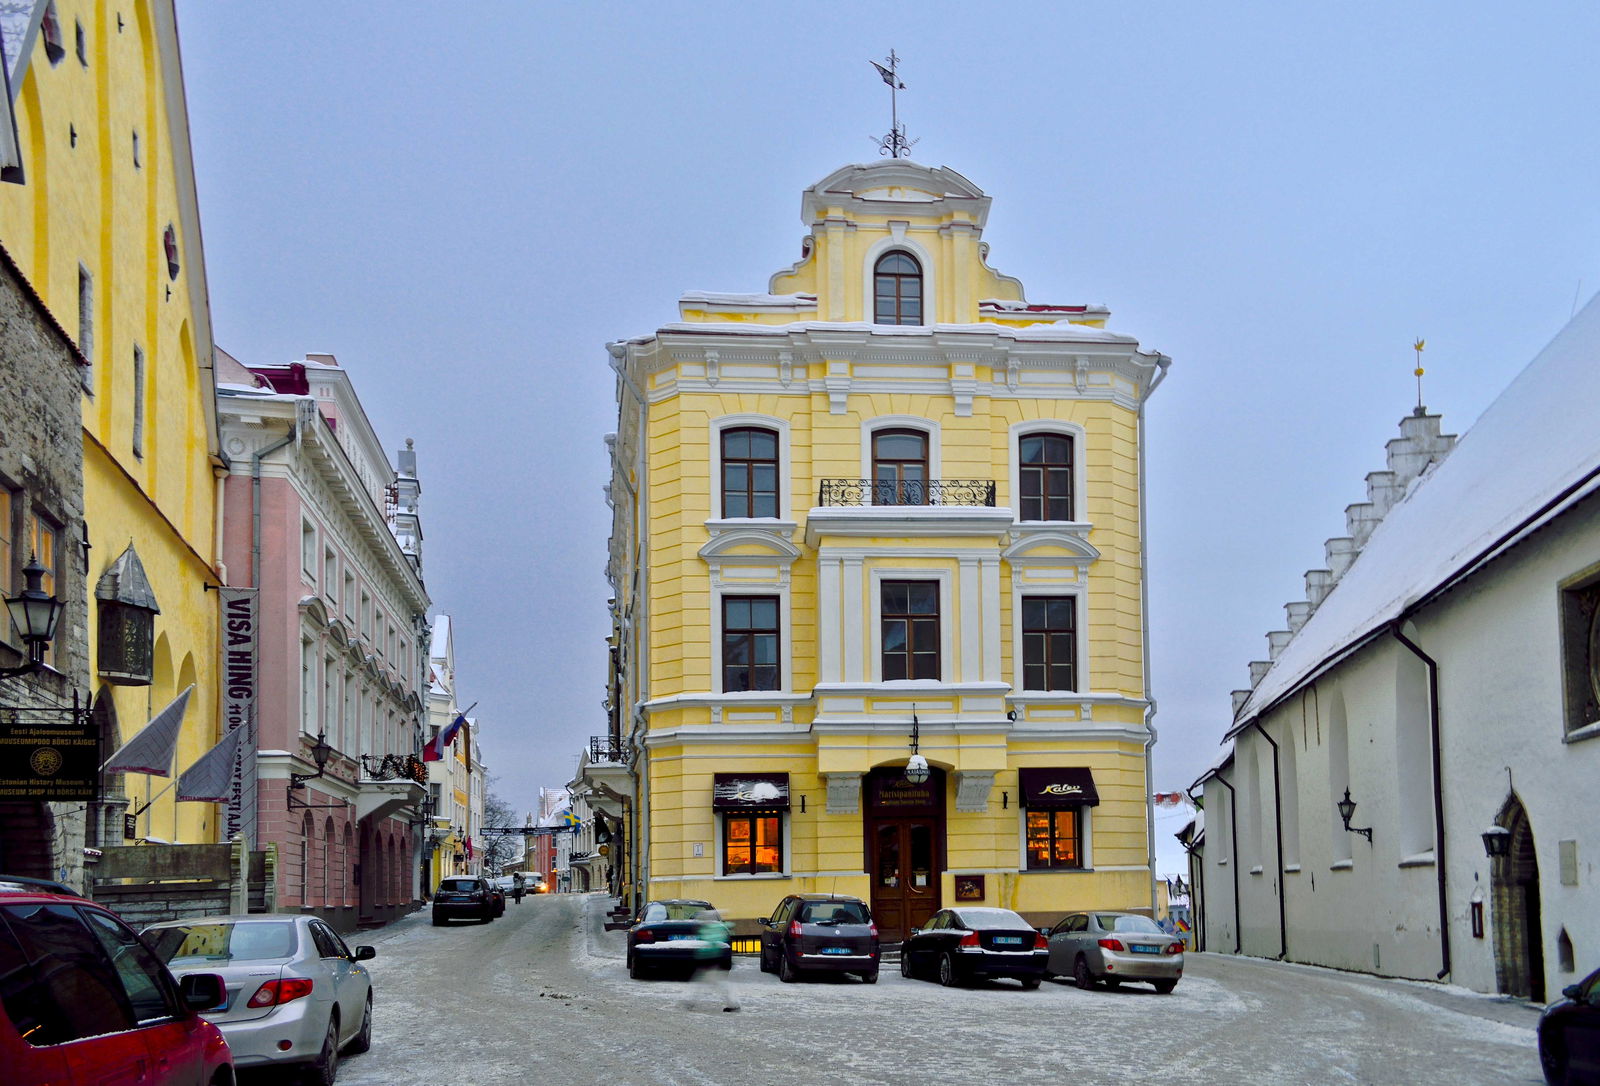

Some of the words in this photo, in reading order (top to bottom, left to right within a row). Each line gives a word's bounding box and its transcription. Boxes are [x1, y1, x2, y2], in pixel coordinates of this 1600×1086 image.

[227, 598, 252, 646] VISA
[228, 650, 253, 699] HING
[28, 788, 46, 796] SHOP
[47, 788, 56, 796] IN
[1039, 784, 1083, 795] Kalev
